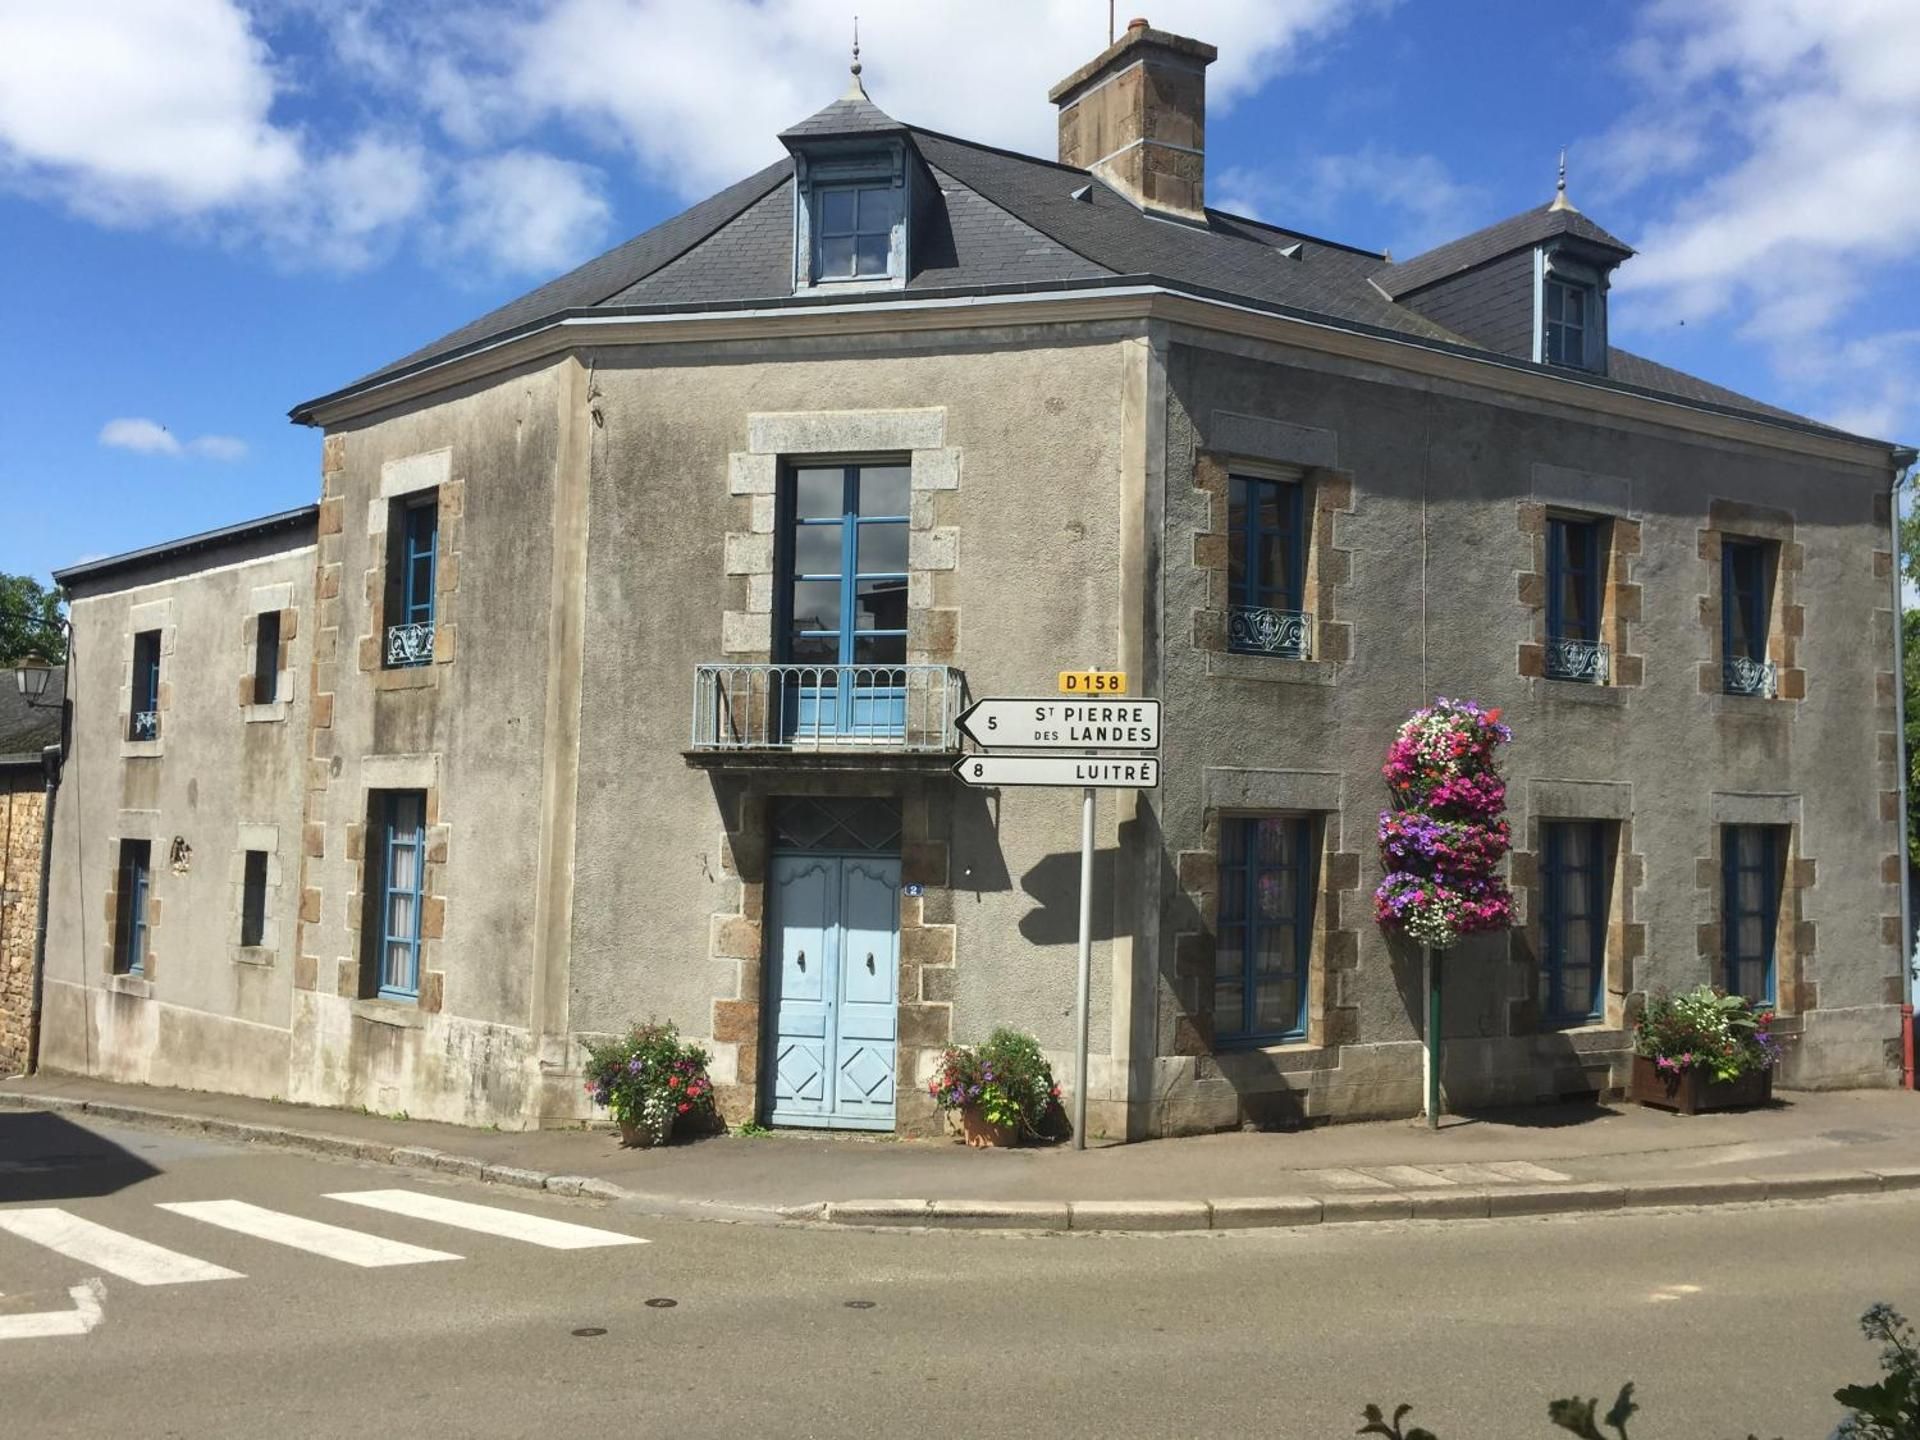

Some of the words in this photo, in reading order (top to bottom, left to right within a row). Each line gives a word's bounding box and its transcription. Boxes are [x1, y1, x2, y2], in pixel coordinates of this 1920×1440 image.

[1066, 675, 1077, 690] D
[1083, 675, 1119, 690] 158
[1064, 707, 1143, 722] PIERRE
[987, 716, 998, 730] 5
[1034, 730, 1059, 741] DES
[1070, 726, 1152, 742] LANDES
[973, 763, 984, 777] 8
[1076, 763, 1150, 780] LUITRÉ
[910, 885, 918, 895] 2
